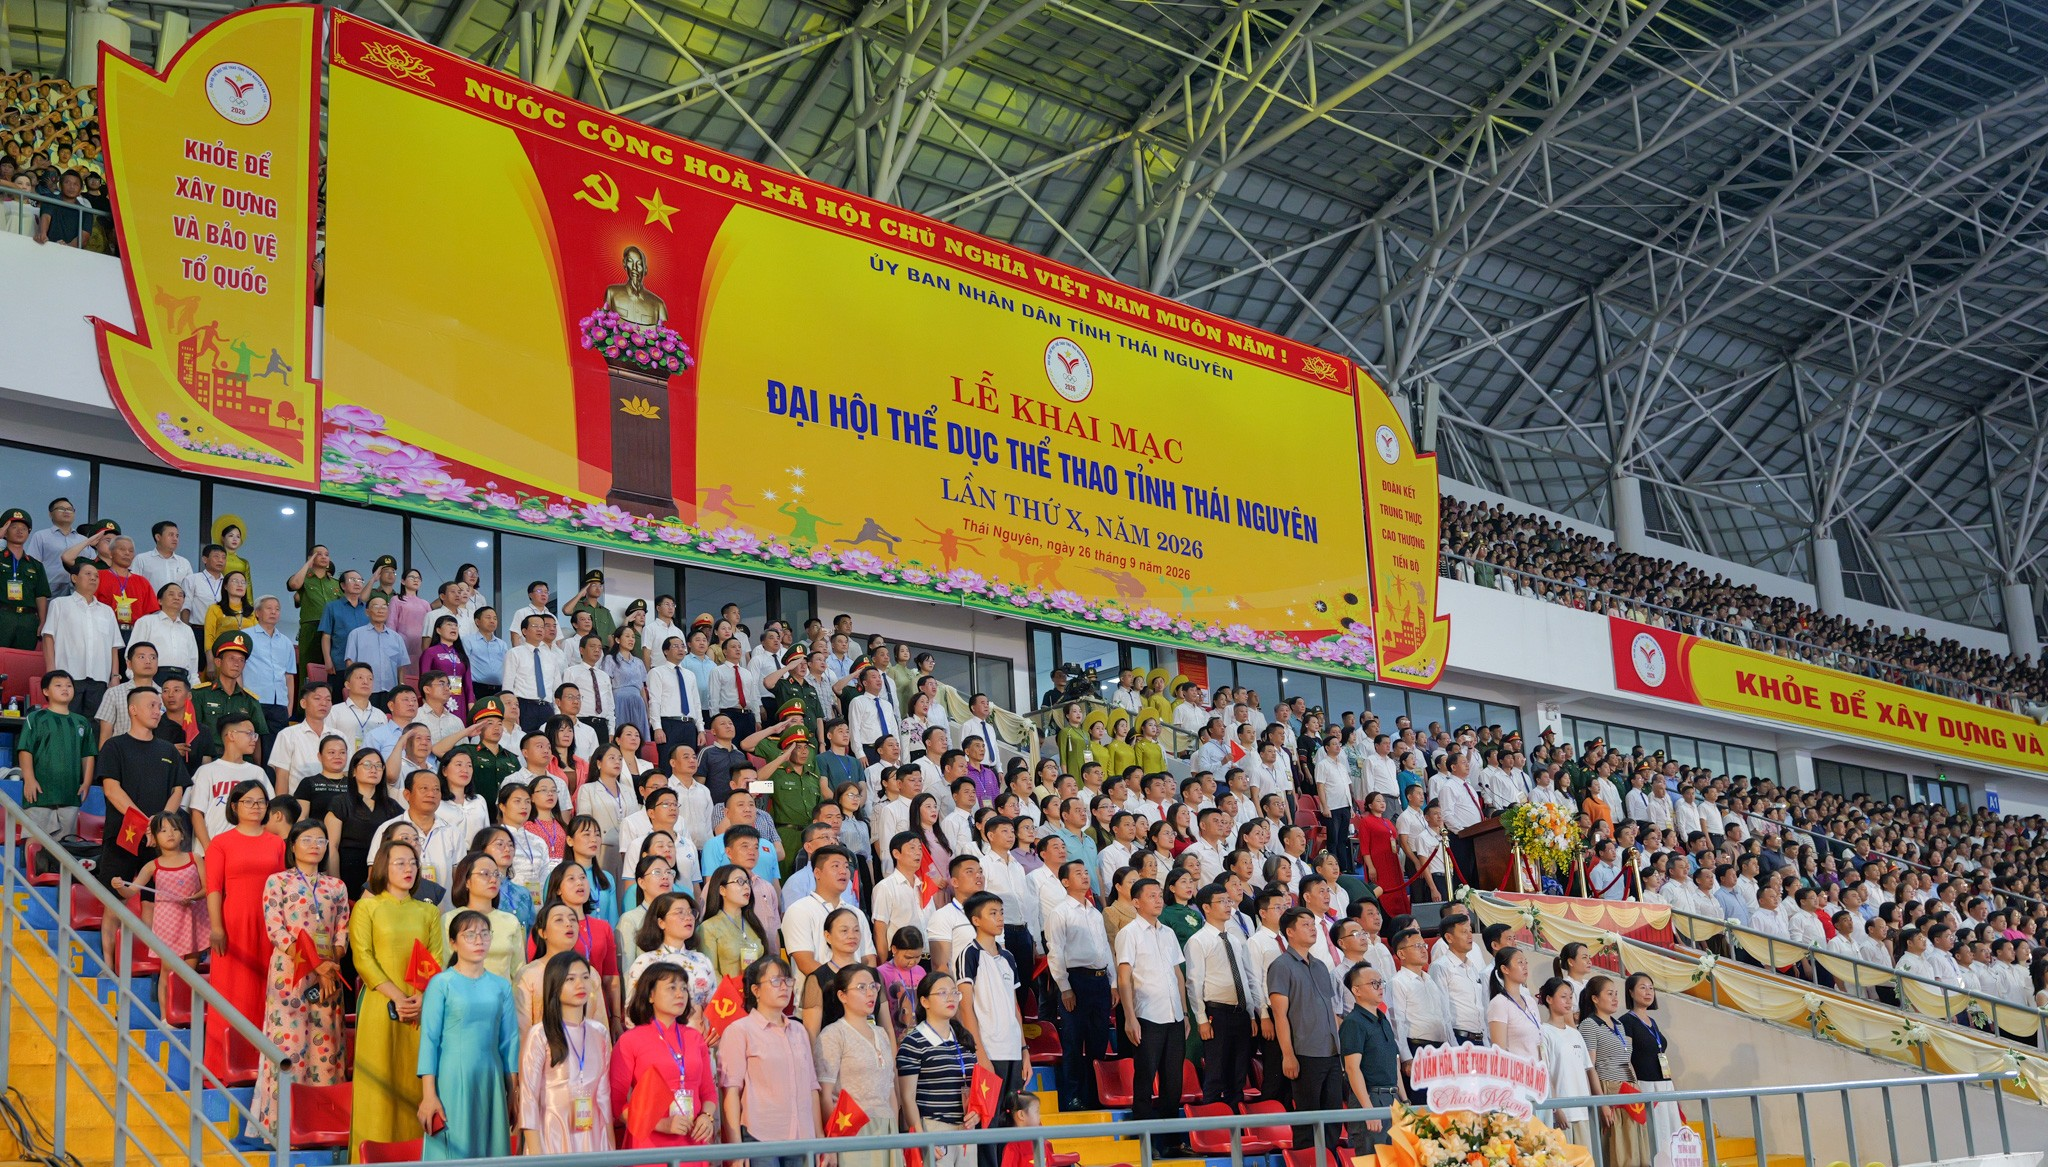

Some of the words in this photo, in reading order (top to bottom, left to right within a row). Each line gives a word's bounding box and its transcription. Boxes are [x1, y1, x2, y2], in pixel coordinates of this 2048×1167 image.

[186, 140, 237, 169] KHỎE
[245, 152, 271, 177] ĐỂ
[176, 177, 215, 203] XÂY
[223, 188, 276, 218] DỰNG
[174, 216, 199, 240] VÀ
[207, 222, 246, 250] BẢO
[254, 234, 276, 261] VỆ
[466, 78, 565, 128] NƯỚC
[578, 120, 673, 165] CỘNG
[684, 155, 752, 192] HOÀ
[761, 180, 807, 209] XÃ
[816, 197, 871, 228] HỘI
[880, 218, 935, 247] CHỦ
[944, 237, 1028, 279] NGHĨA
[1034, 268, 1089, 299] VIỆT
[1097, 289, 1150, 319] NAM
[1156, 309, 1221, 342] MUÔN
[1227, 332, 1275, 359] NĂM
[1281, 349, 1287, 363] !
[182, 255, 208, 282] TỔ
[214, 266, 266, 294] QUỐC
[870, 254, 898, 275] ỦY
[908, 268, 950, 291] BAN
[959, 283, 1014, 312] NHÂN
[1022, 304, 1060, 327] DÂN
[1067, 319, 1110, 343] TỈNH
[1117, 335, 1156, 357] THÁI
[1164, 350, 1232, 380] NGUYÊN
[951, 371, 999, 414] LỄ
[1010, 394, 1101, 442] KHAI
[1111, 423, 1182, 464] MẠC
[767, 380, 818, 427] ĐẠI
[829, 393, 878, 440] HỘI
[887, 405, 938, 449] THỂ
[947, 422, 998, 466] DỤC
[1006, 436, 1051, 479] THỂ
[1058, 452, 1118, 495] THAO
[1125, 464, 1176, 510] TỈNH
[1182, 485, 1229, 523] THÁI
[1237, 498, 1317, 543] NGUYÊN
[1382, 480, 1401, 495] ĐOÀN
[1403, 485, 1415, 499] KẾT
[941, 472, 996, 510] LẦN
[1005, 494, 1060, 525] THỨ
[1066, 509, 1089, 537] X,
[1096, 516, 1149, 547] NĂM
[1157, 532, 1203, 559] 2026
[1380, 504, 1403, 519] TRUNG
[1405, 511, 1422, 525] THỰC
[963, 518, 988, 534] Thái
[994, 526, 1042, 549] Nguyên,
[1047, 541, 1074, 557] ngày
[1079, 546, 1090, 558] 26
[1095, 550, 1126, 569] tháng
[1130, 557, 1135, 568] 9
[1140, 562, 1161, 574] năm
[1166, 566, 1190, 580] 2026
[1382, 529, 1396, 541] CAO
[1398, 533, 1425, 549] THƯỢNG
[1392, 554, 1409, 570] TIẾN
[1409, 559, 1420, 575] BỘ
[1736, 671, 1821, 709] KHỎE
[1830, 690, 1868, 719] ĐỂ
[1876, 702, 1928, 732] XÂY
[1938, 717, 2007, 749] DỰNG
[2012, 731, 2045, 757] VÀ
[1989, 795, 1998, 809] A1
[1423, 1052, 1437, 1079] VĂN
[1457, 1046, 1469, 1074] THỂ
[1471, 1053, 1487, 1074] THAO
[1490, 1050, 1499, 1076] VÀ
[1500, 1056, 1509, 1078] DU
[1510, 1060, 1524, 1085] LỊCH
[1526, 1062, 1534, 1087] HÀ
